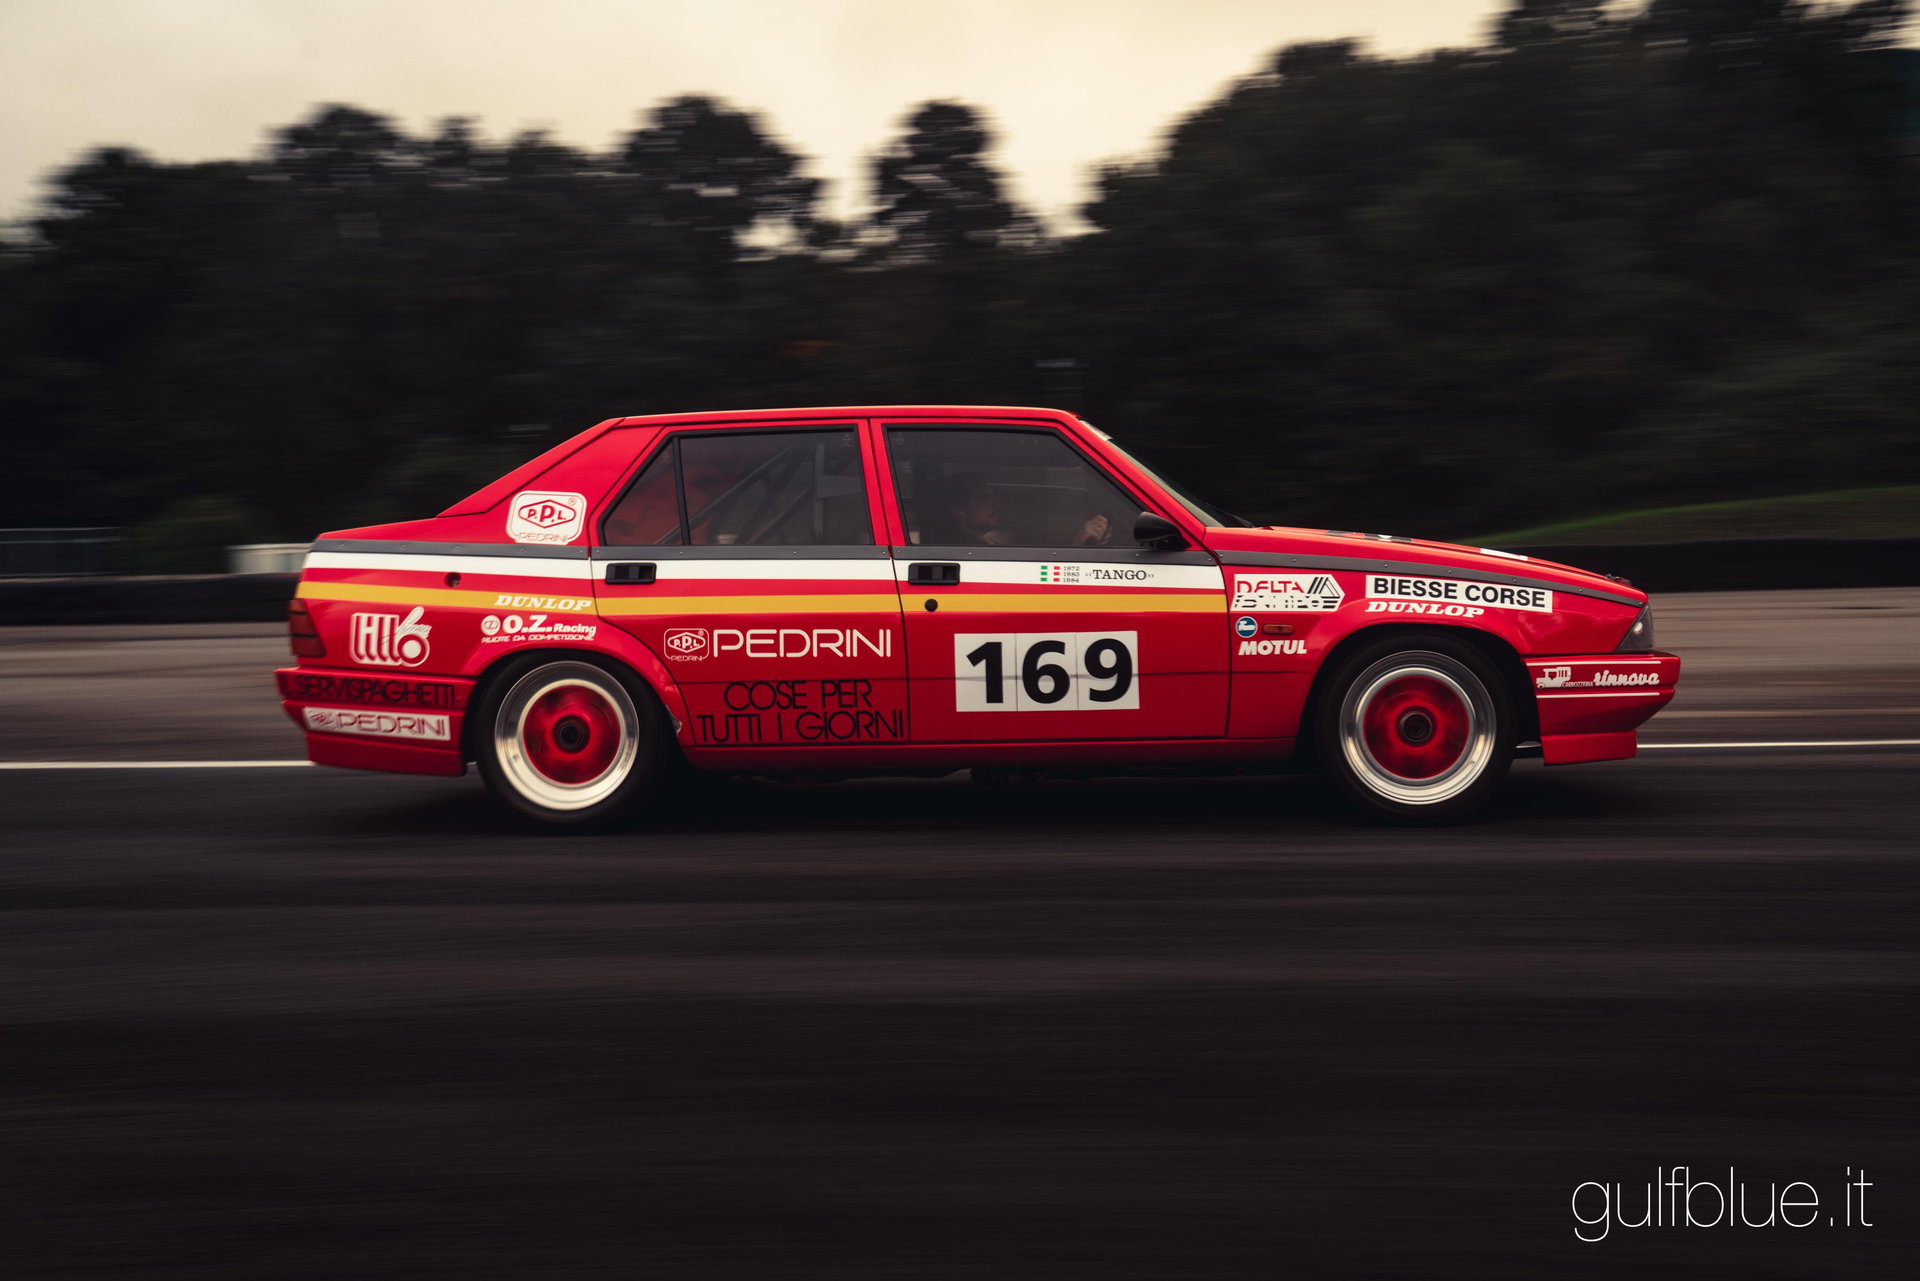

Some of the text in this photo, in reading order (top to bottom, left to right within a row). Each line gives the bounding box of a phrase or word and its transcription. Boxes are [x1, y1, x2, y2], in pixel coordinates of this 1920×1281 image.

[1237, 580, 1305, 594] DELTA
[1373, 577, 1546, 608] BIESSE CORSE
[493, 594, 593, 612] DUNLOP
[1365, 601, 1485, 618] DUNLOP
[502, 614, 598, 637] O.Z. Racing
[480, 632, 595, 644] RUOTE DA COMPETIZIONE
[713, 629, 891, 658] PEDRINI
[1238, 640, 1308, 656] MOTUL
[966, 637, 1134, 705] 169
[1593, 669, 1660, 687] rinnova
[723, 679, 873, 711] COSE PER
[335, 712, 446, 738] PEDRINI
[696, 710, 905, 743] TUTTI I GIORNI
